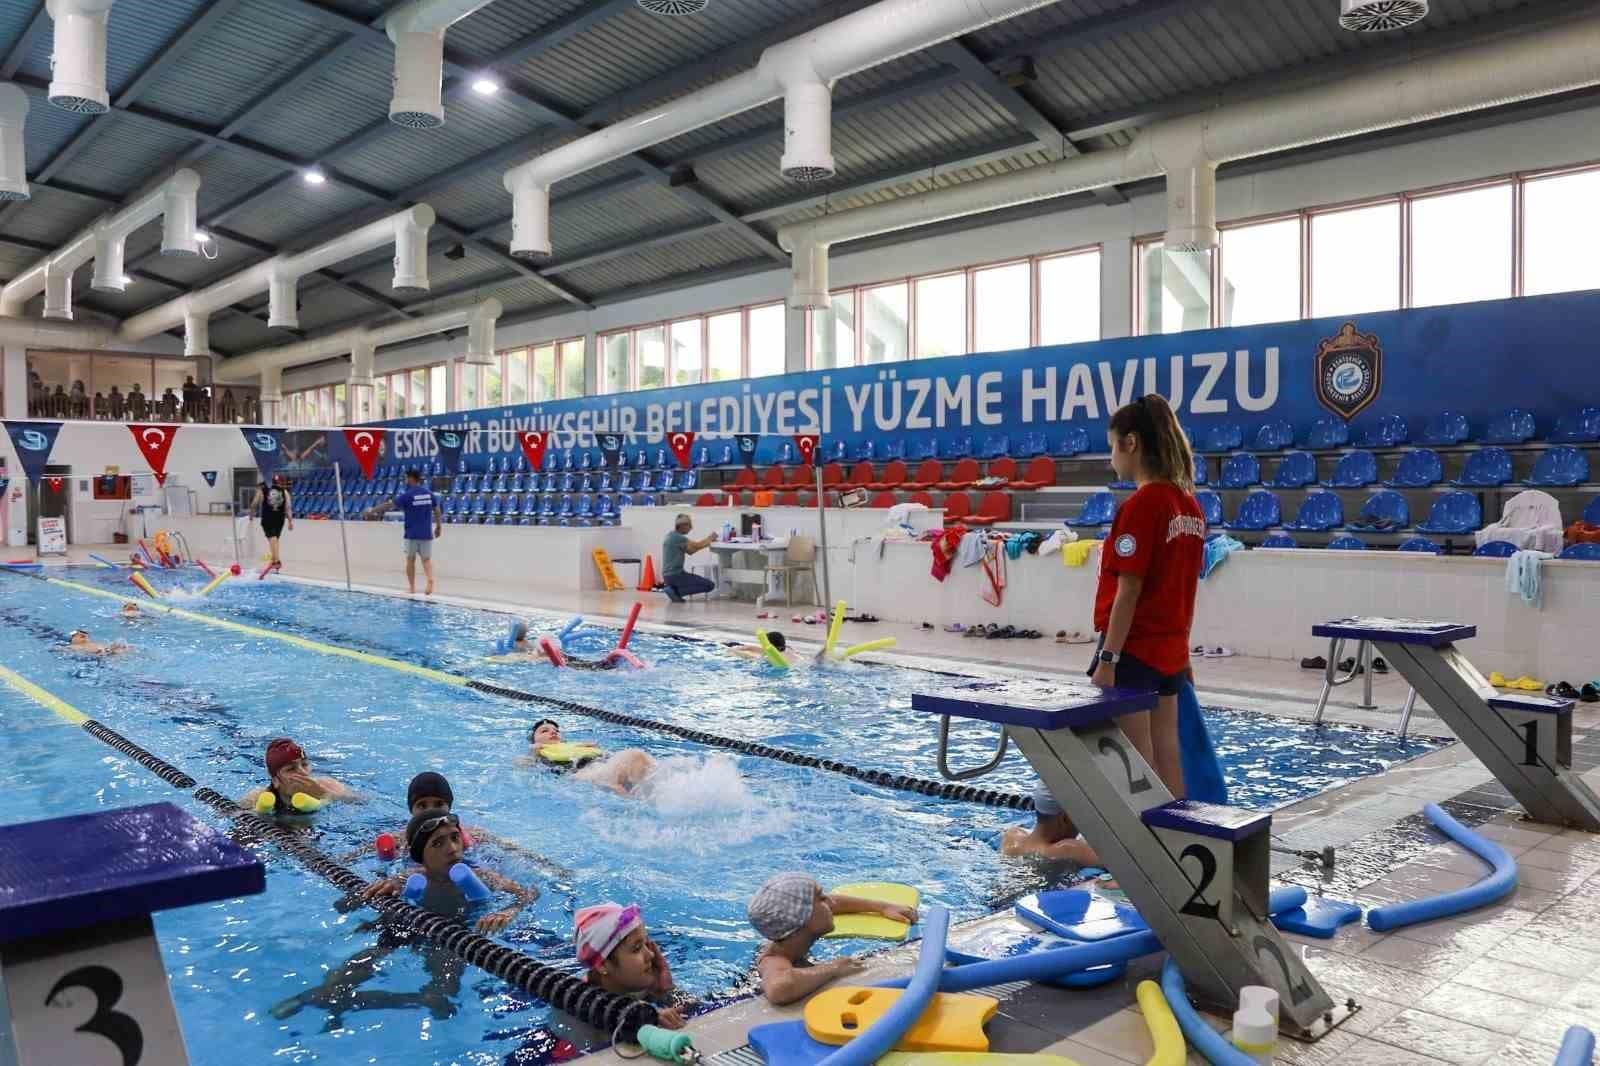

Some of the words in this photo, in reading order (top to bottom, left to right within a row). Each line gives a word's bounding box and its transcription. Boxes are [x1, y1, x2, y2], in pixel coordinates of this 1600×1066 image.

[844, 369, 1003, 432] YÜZME
[1021, 346, 1280, 422] HAVUZU
[1097, 736, 1153, 794] 2
[1517, 720, 1545, 768] 1
[1179, 843, 1221, 921] 2
[1253, 935, 1314, 1006] 2
[45, 964, 144, 1066] 3
